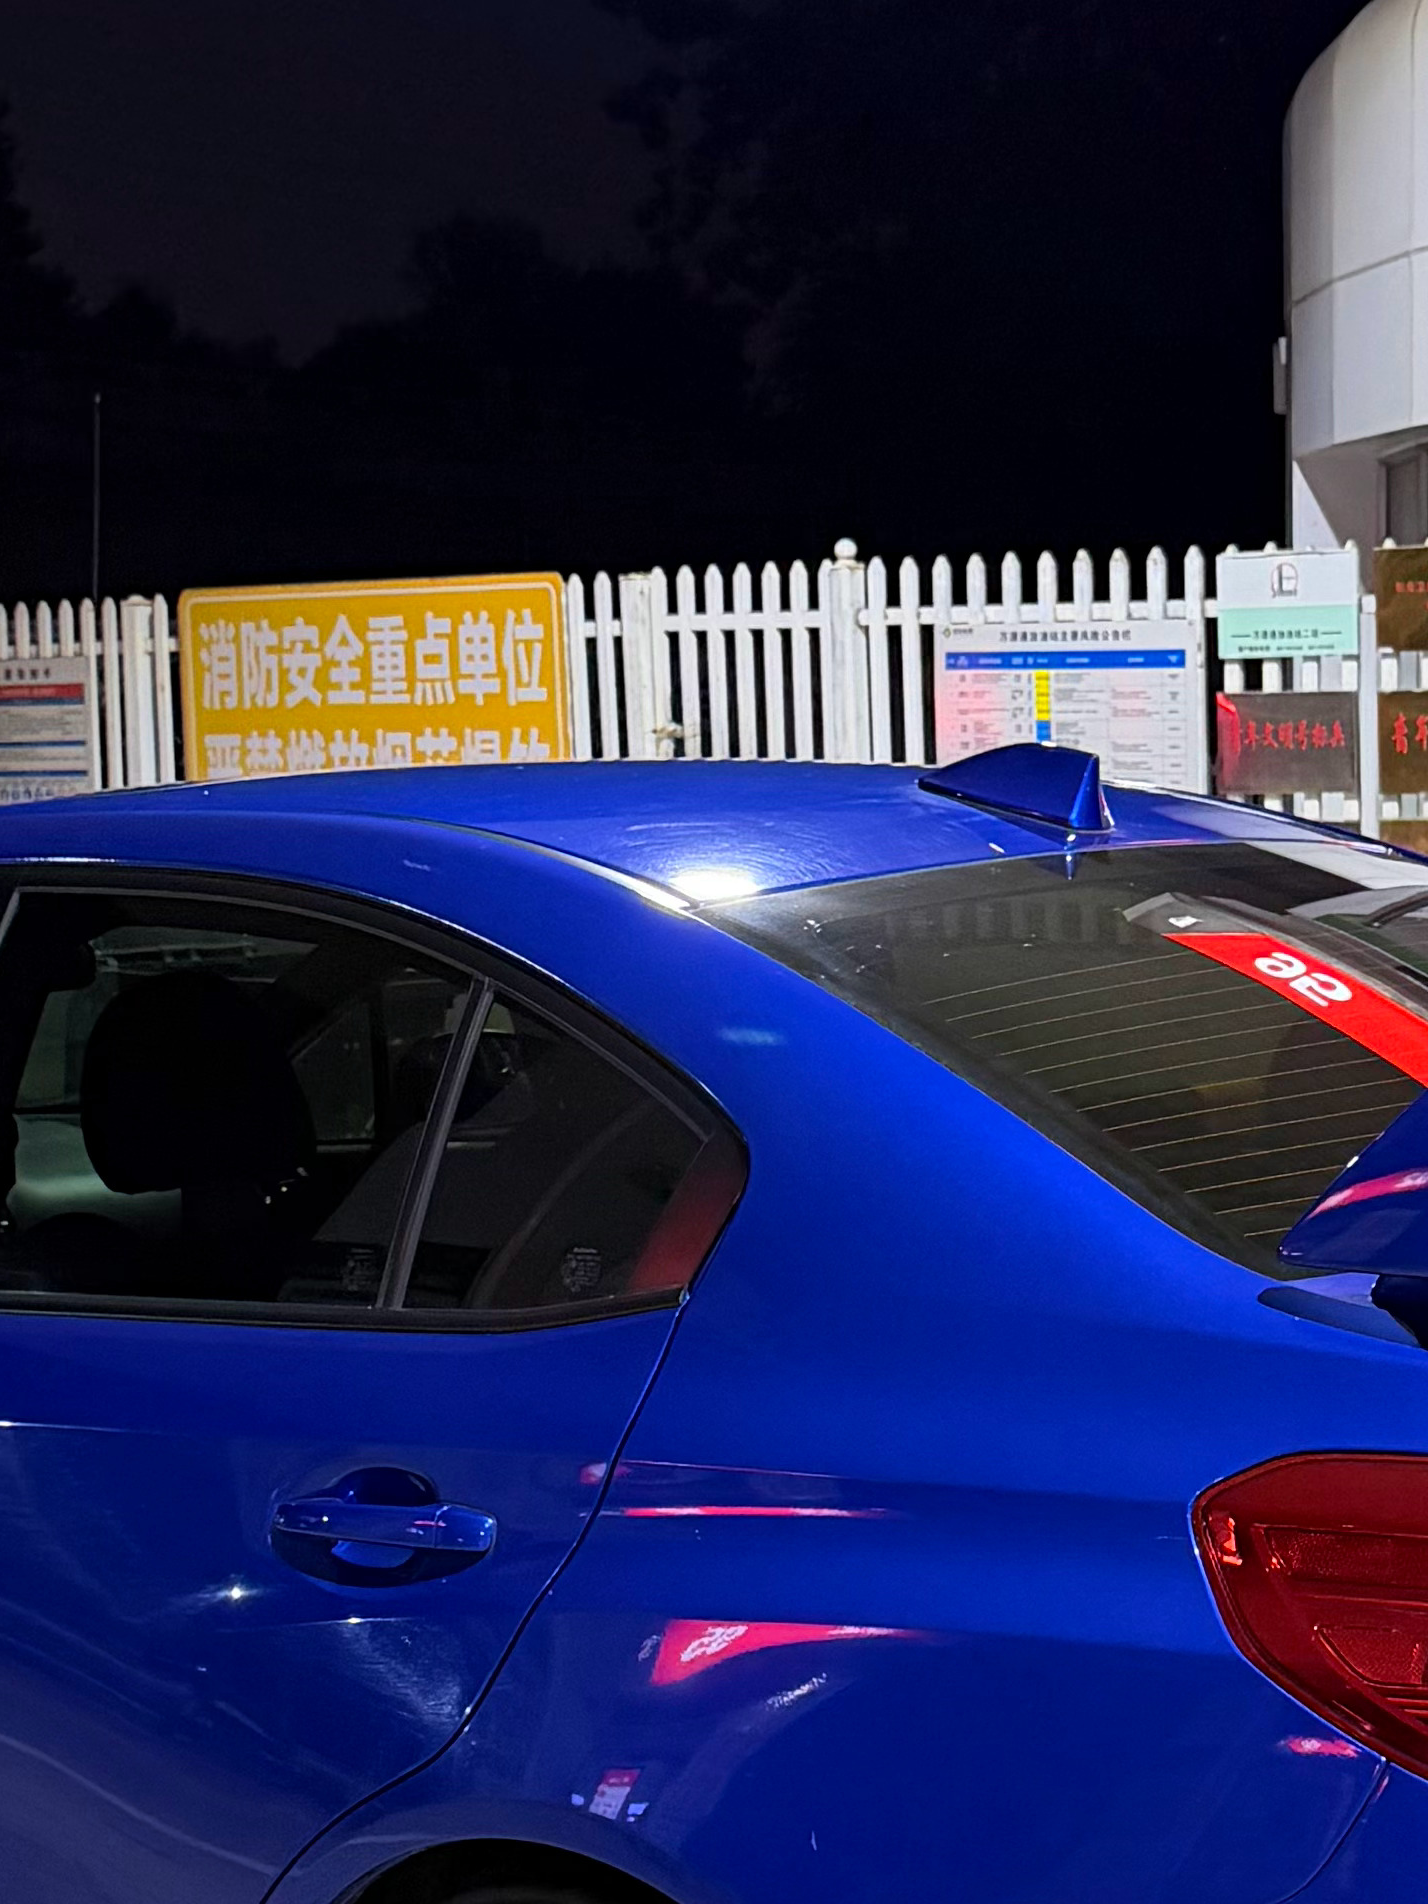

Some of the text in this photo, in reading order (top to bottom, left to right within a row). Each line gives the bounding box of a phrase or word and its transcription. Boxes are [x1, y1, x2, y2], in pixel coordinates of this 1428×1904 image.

[198, 607, 549, 712] 消防安全重点单位
